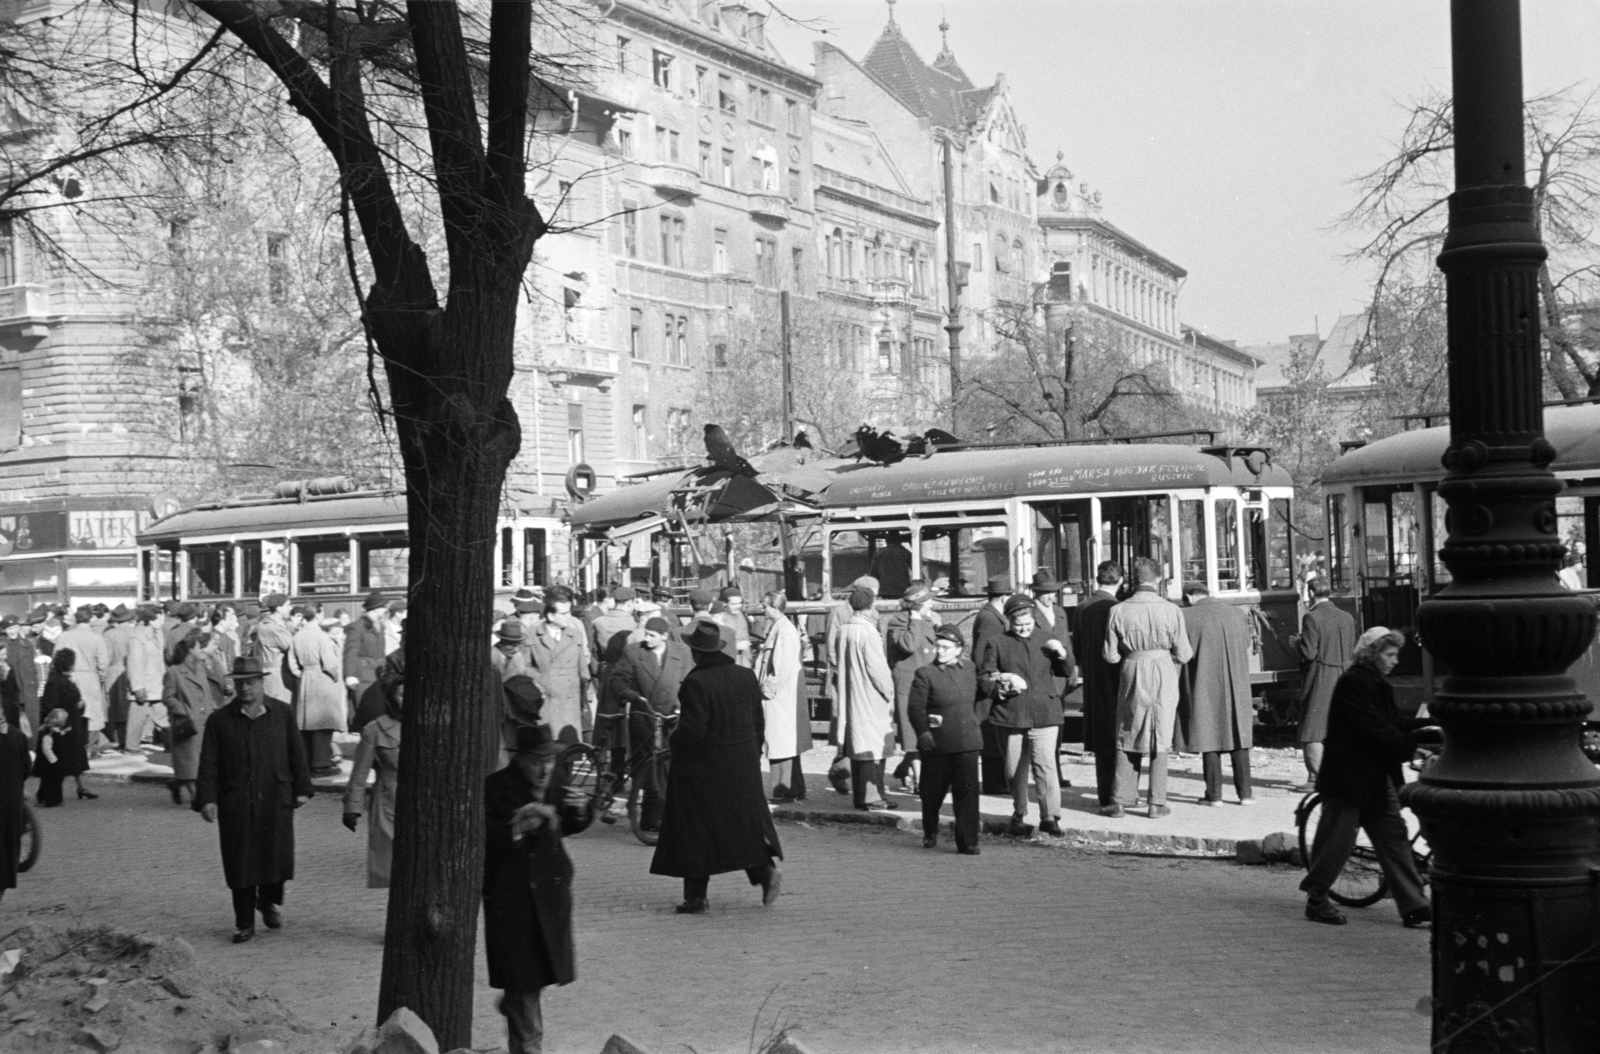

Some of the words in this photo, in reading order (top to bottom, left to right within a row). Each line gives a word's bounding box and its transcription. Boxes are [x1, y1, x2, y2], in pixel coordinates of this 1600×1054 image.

[1073, 468, 1110, 480] MARSA
[1113, 464, 1157, 477] MAGYAR
[1151, 472, 1194, 482] RUSZKIK
